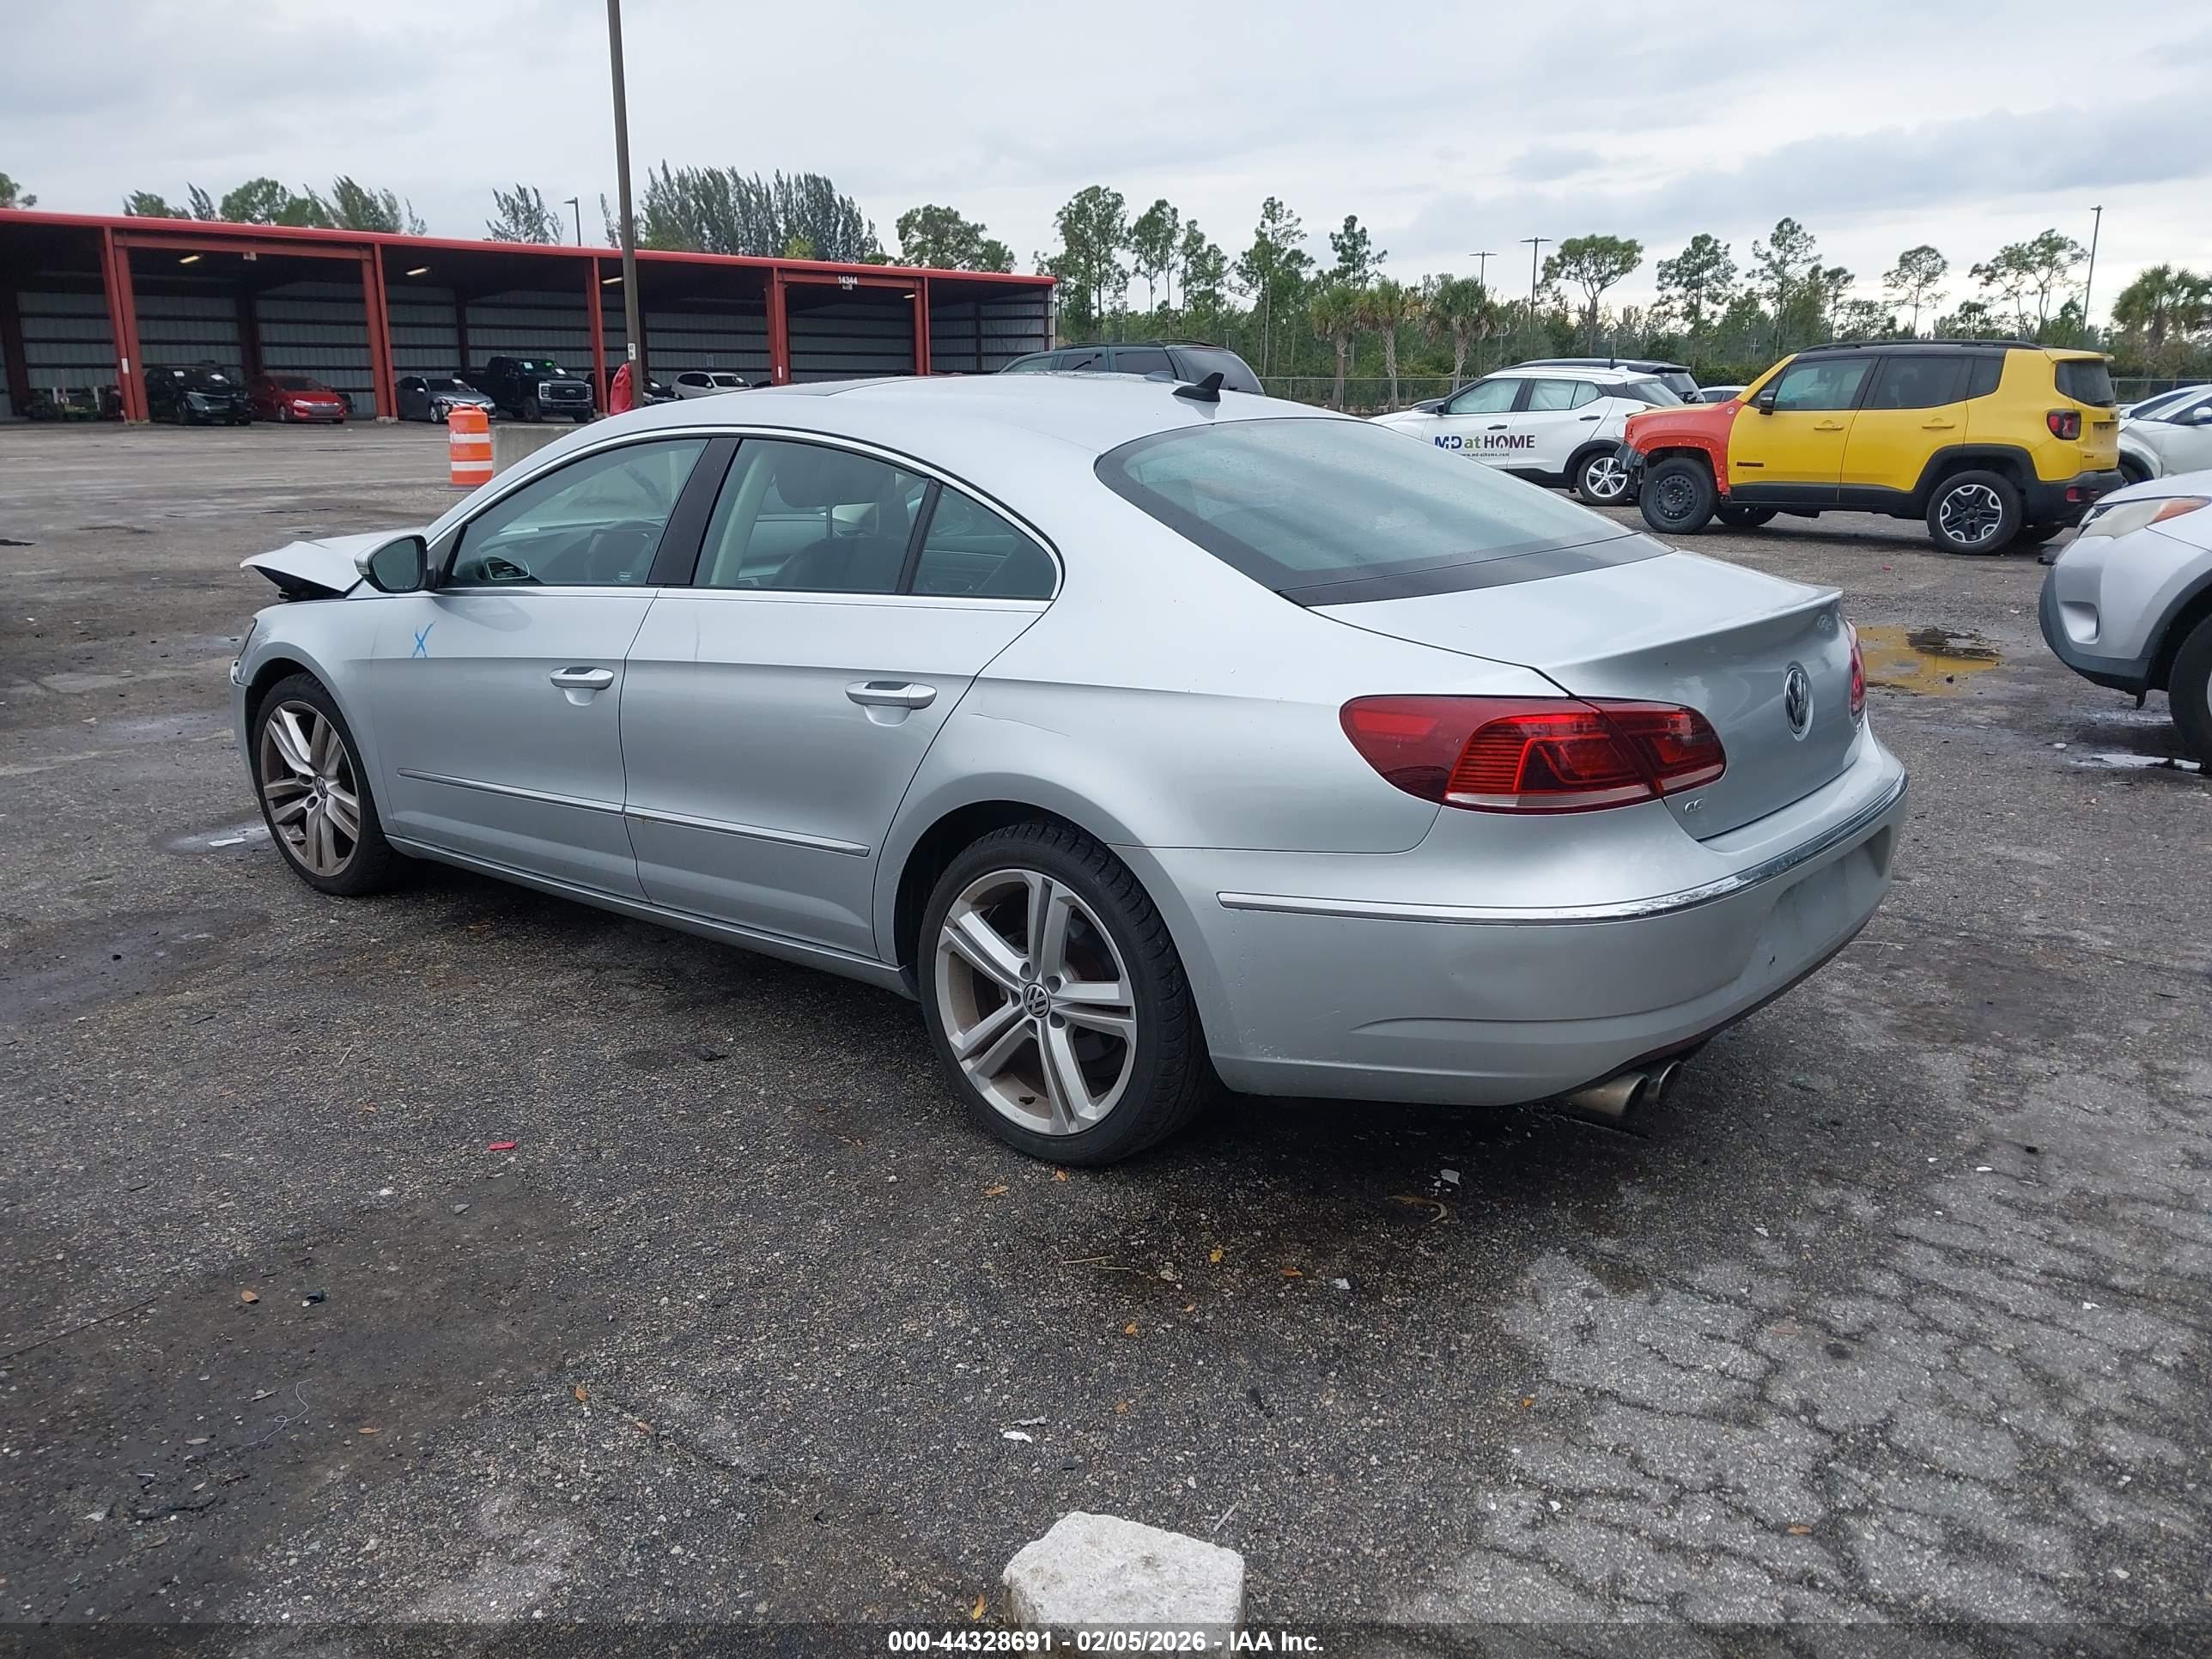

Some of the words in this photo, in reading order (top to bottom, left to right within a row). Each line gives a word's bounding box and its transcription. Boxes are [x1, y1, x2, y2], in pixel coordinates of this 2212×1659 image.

[837, 276, 858, 285] 14344
[1434, 435, 1462, 449] MD
[1464, 435, 1481, 449] at
[1484, 434, 1535, 449] HOME
